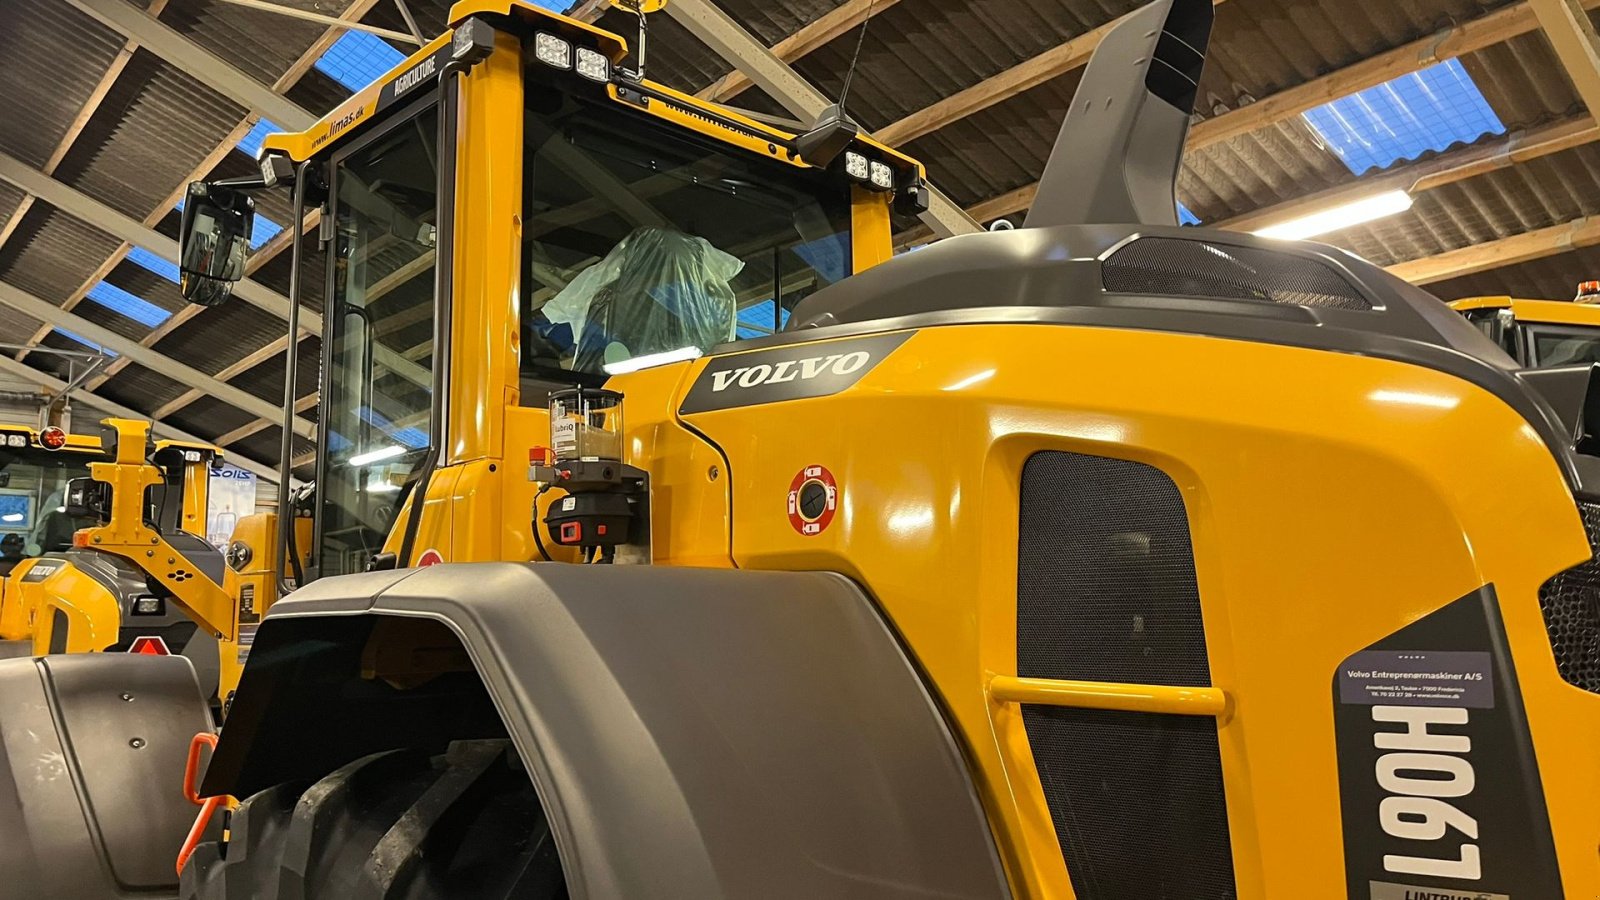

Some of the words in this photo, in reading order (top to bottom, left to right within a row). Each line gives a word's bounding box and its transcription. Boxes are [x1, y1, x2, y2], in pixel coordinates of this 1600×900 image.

[394, 55, 436, 97] AGRICULTURE
[311, 105, 365, 150] www.limas.dk
[711, 351, 870, 392] VOLVO
[1347, 670, 1370, 679] Volvo
[1371, 670, 1463, 681] Entreprenørmaskiner
[1464, 672, 1483, 681] A/S
[1372, 705, 1482, 880] L90H
